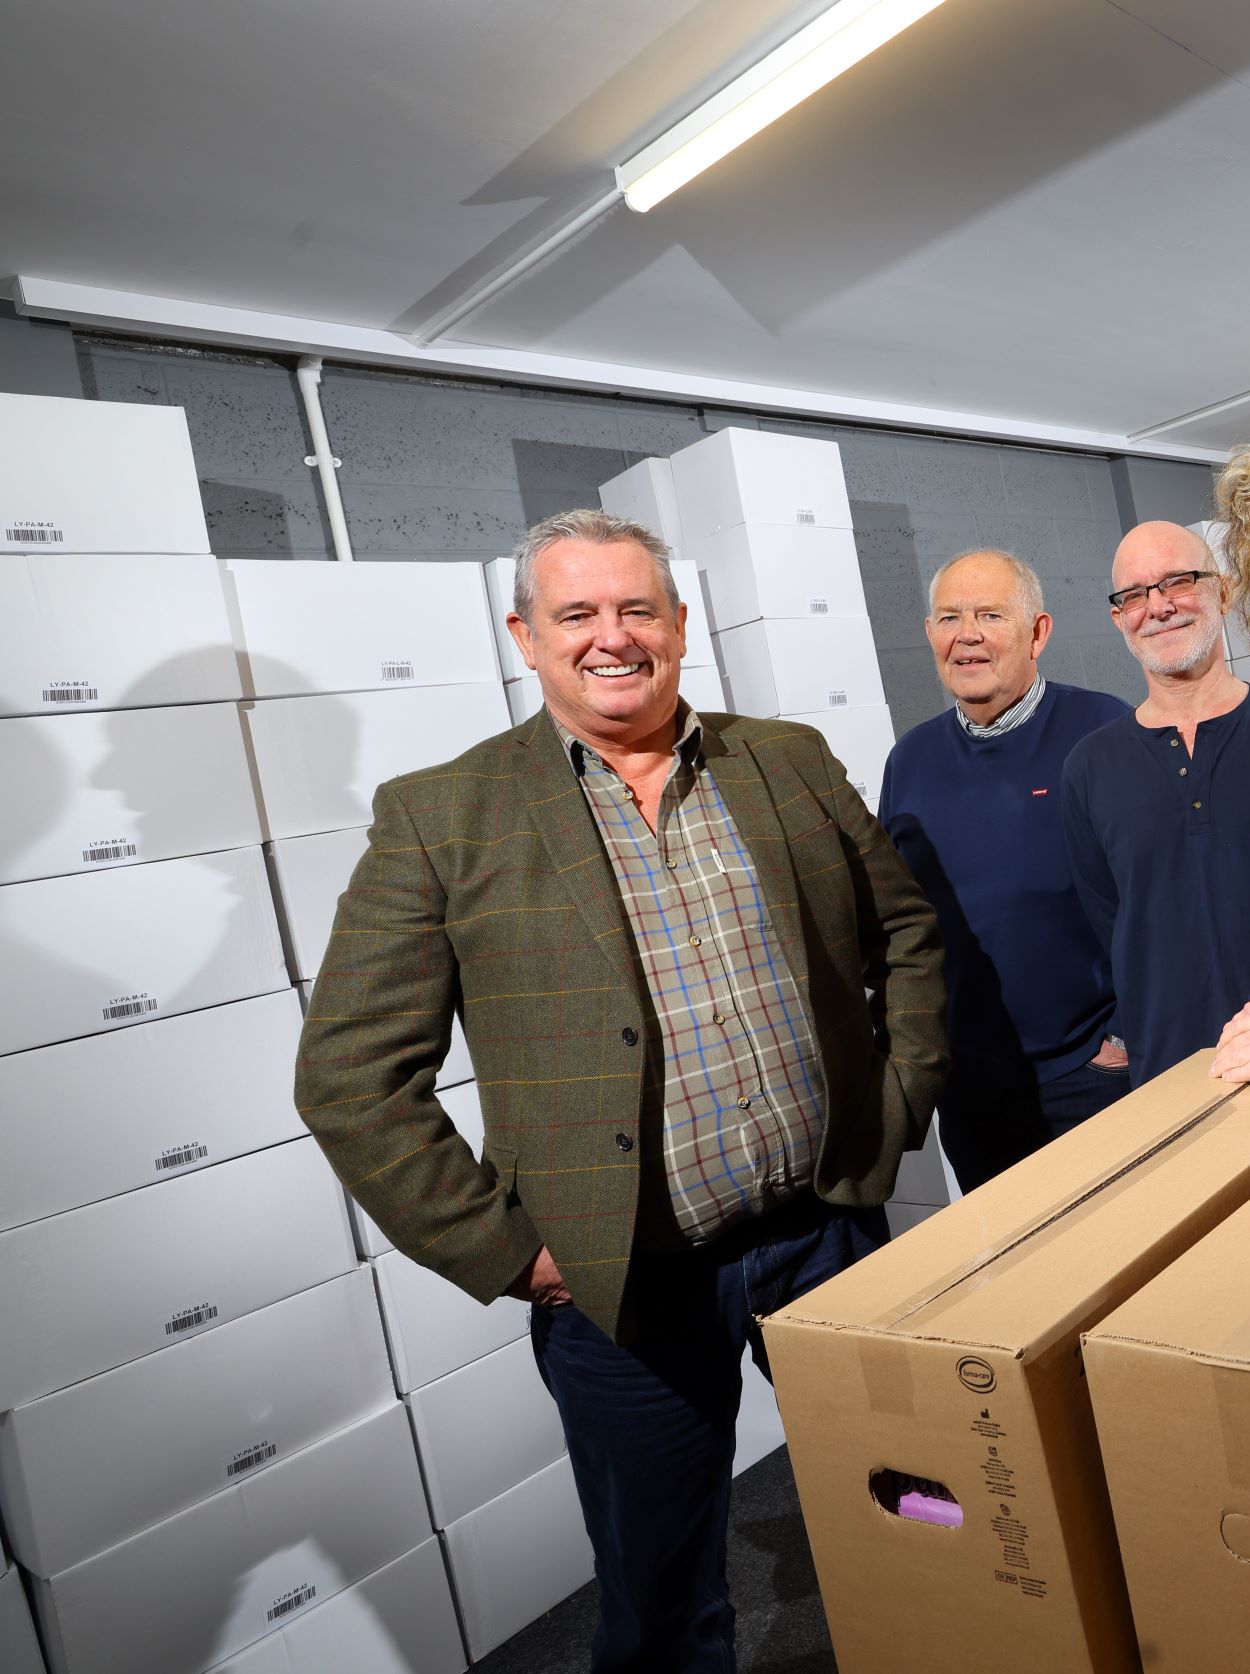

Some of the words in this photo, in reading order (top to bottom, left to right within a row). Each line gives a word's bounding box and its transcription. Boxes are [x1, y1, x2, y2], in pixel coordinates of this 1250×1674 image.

[89, 838, 127, 848] LY-PA-M-42
[109, 992, 148, 1005] LY-PA-M-42
[162, 1141, 199, 1156] LY-PA-M-42
[172, 1302, 209, 1320] LY-PA-M-42
[233, 1440, 268, 1460] LY-PA-M-42
[273, 1583, 308, 1605] LY-PA-M-42
